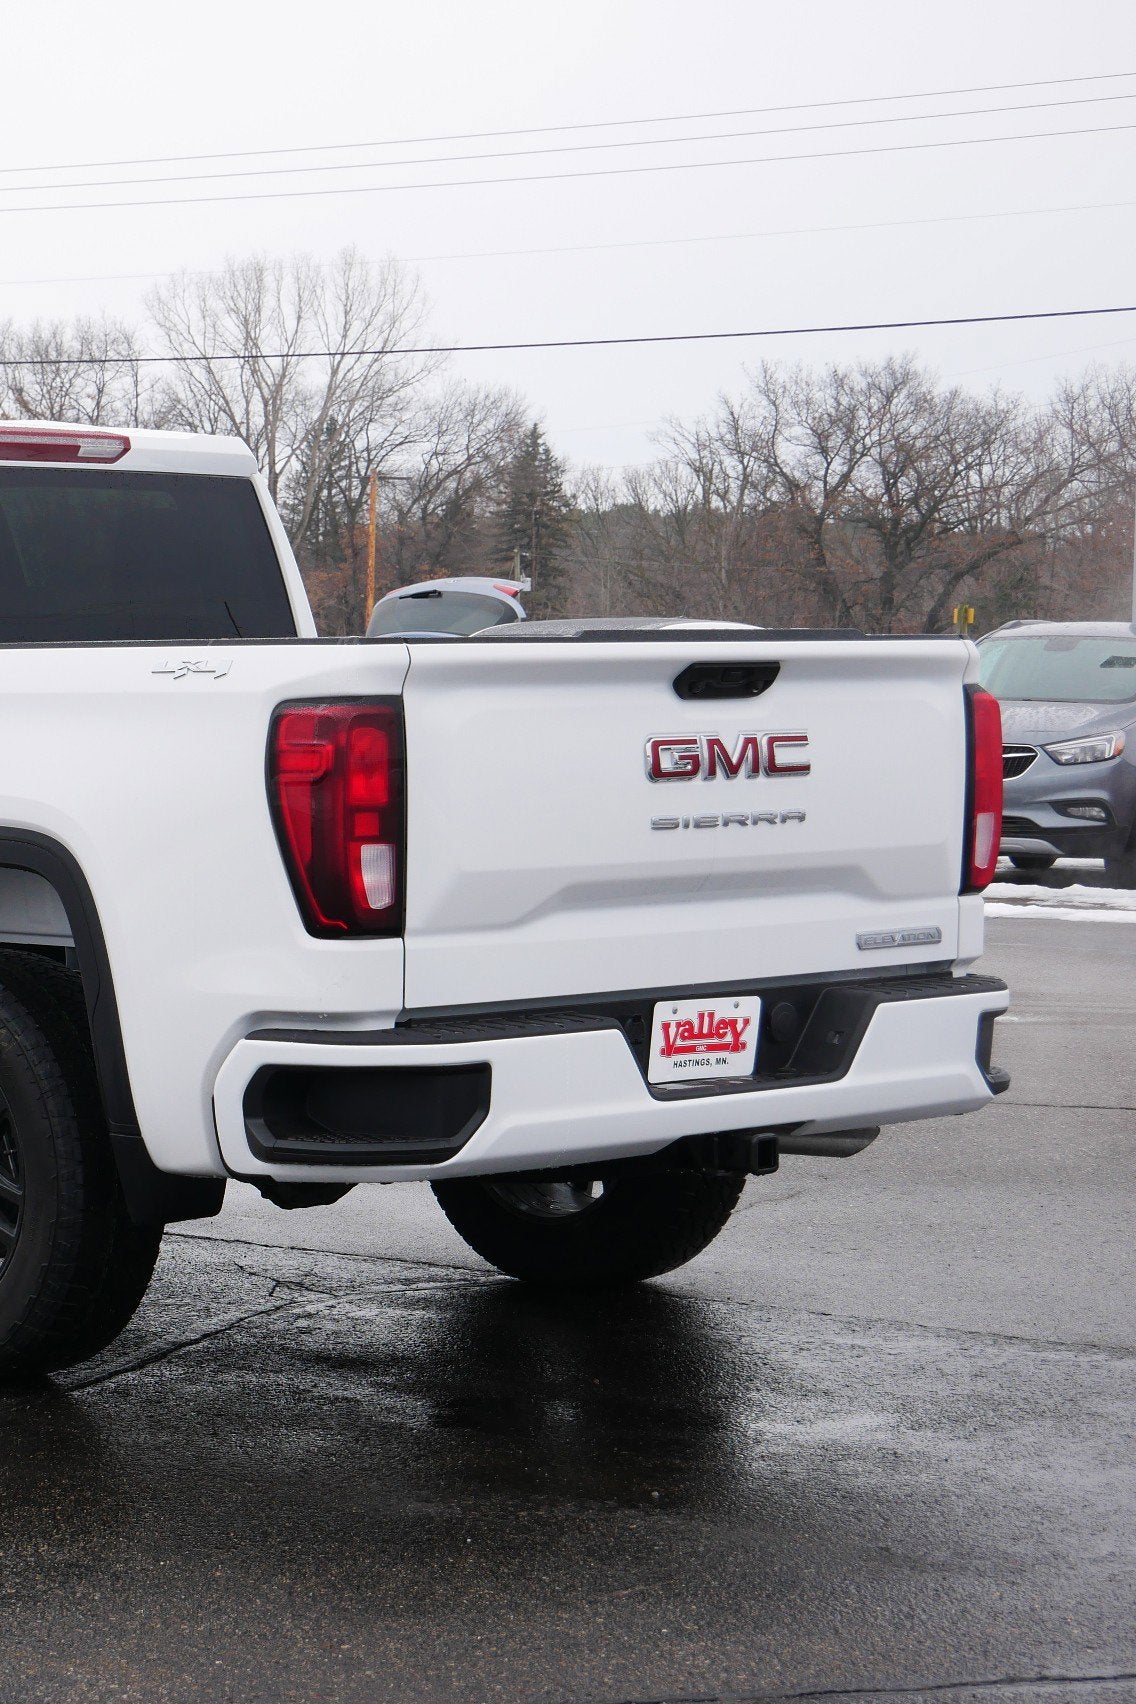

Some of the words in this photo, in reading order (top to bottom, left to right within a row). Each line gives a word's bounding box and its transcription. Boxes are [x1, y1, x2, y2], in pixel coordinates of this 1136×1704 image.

[645, 730, 811, 783] GMC
[650, 808, 807, 830] SIERRA
[660, 1010, 751, 1057] Valley
[695, 1044, 708, 1052] GMC
[673, 1058, 712, 1069] HASTINGS,
[715, 1057, 729, 1066] MN.
